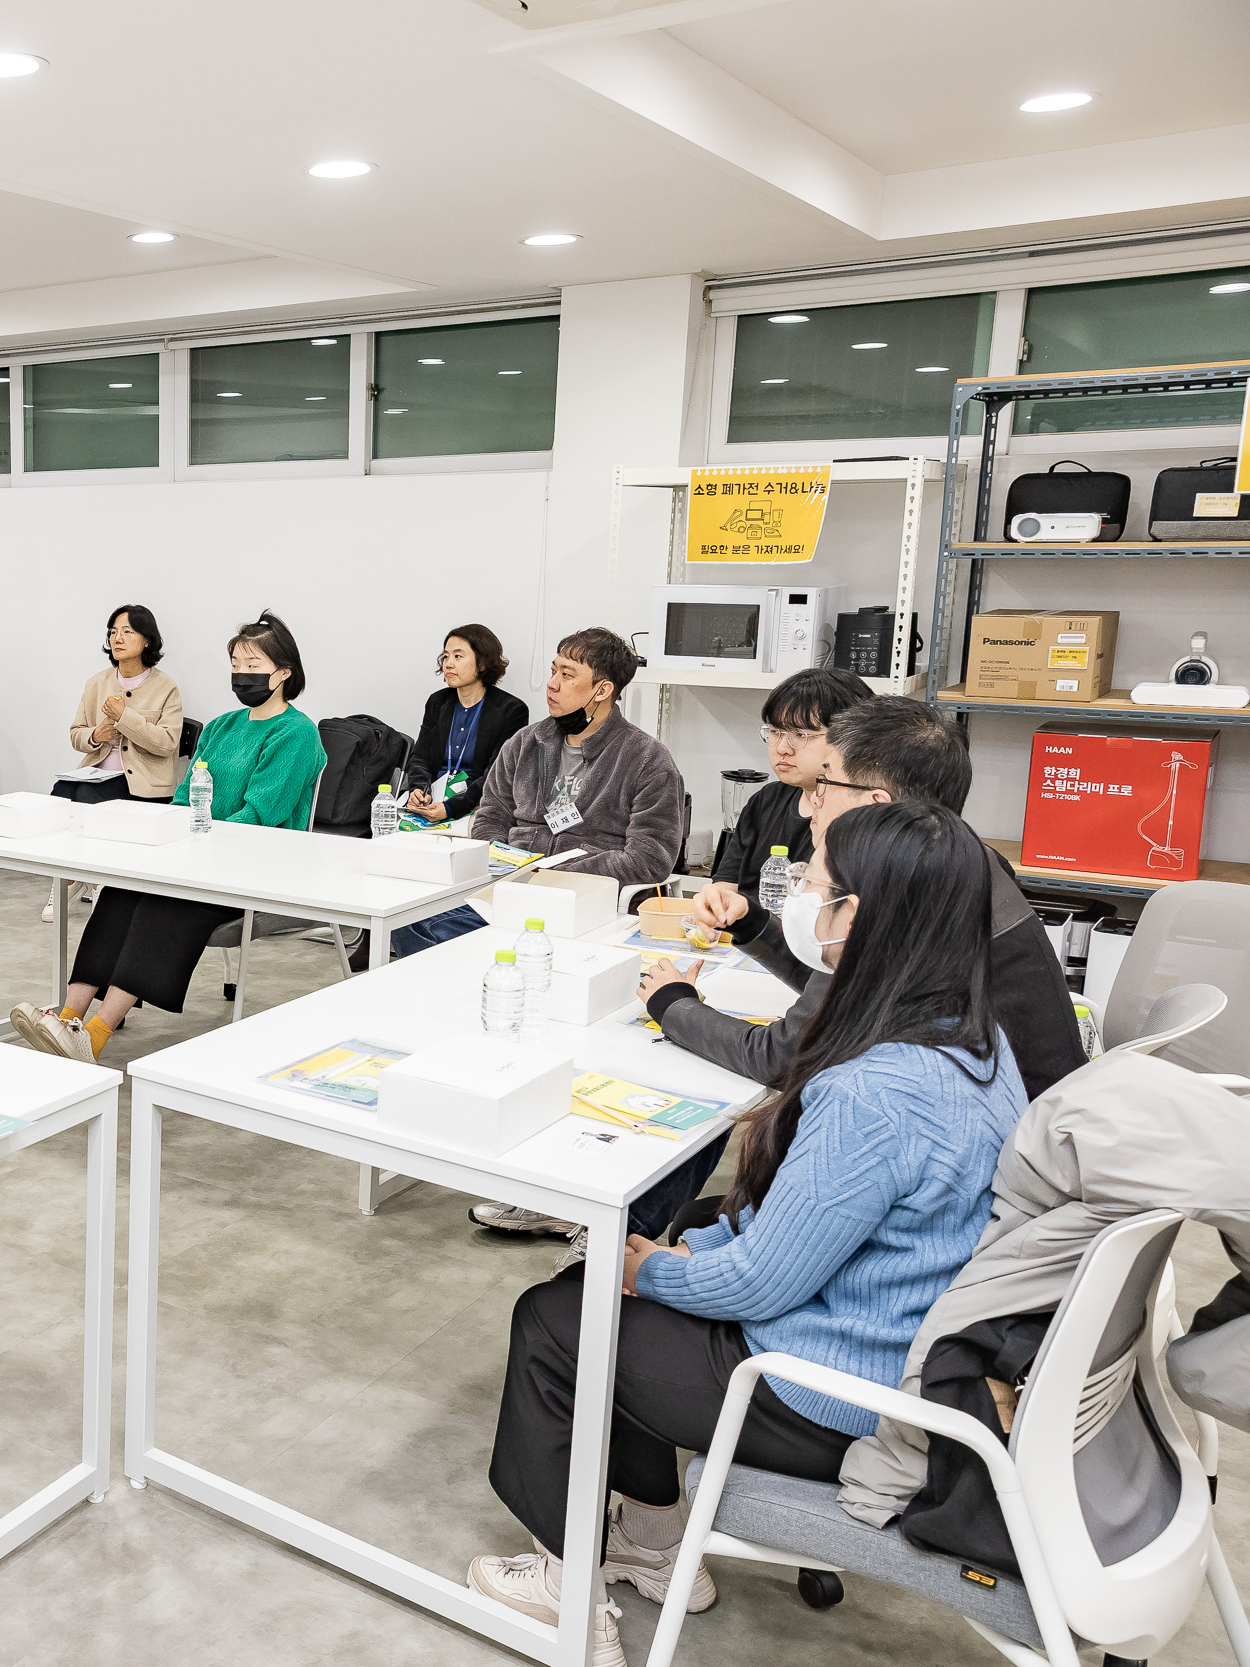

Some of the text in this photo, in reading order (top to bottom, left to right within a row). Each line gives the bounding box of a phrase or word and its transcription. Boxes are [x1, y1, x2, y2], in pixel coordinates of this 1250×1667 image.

[693, 483, 717, 495] 소형
[721, 482, 759, 495] 폐가전
[700, 544, 805, 555] 필요한 분은 가져가세요!
[982, 637, 1037, 647] Panasonic
[1044, 745, 1073, 755] HAAN
[1043, 766, 1081, 780] 한경희
[1041, 779, 1133, 797] 스팀다리미 프로
[1040, 792, 1082, 801] HSI-T210BK
